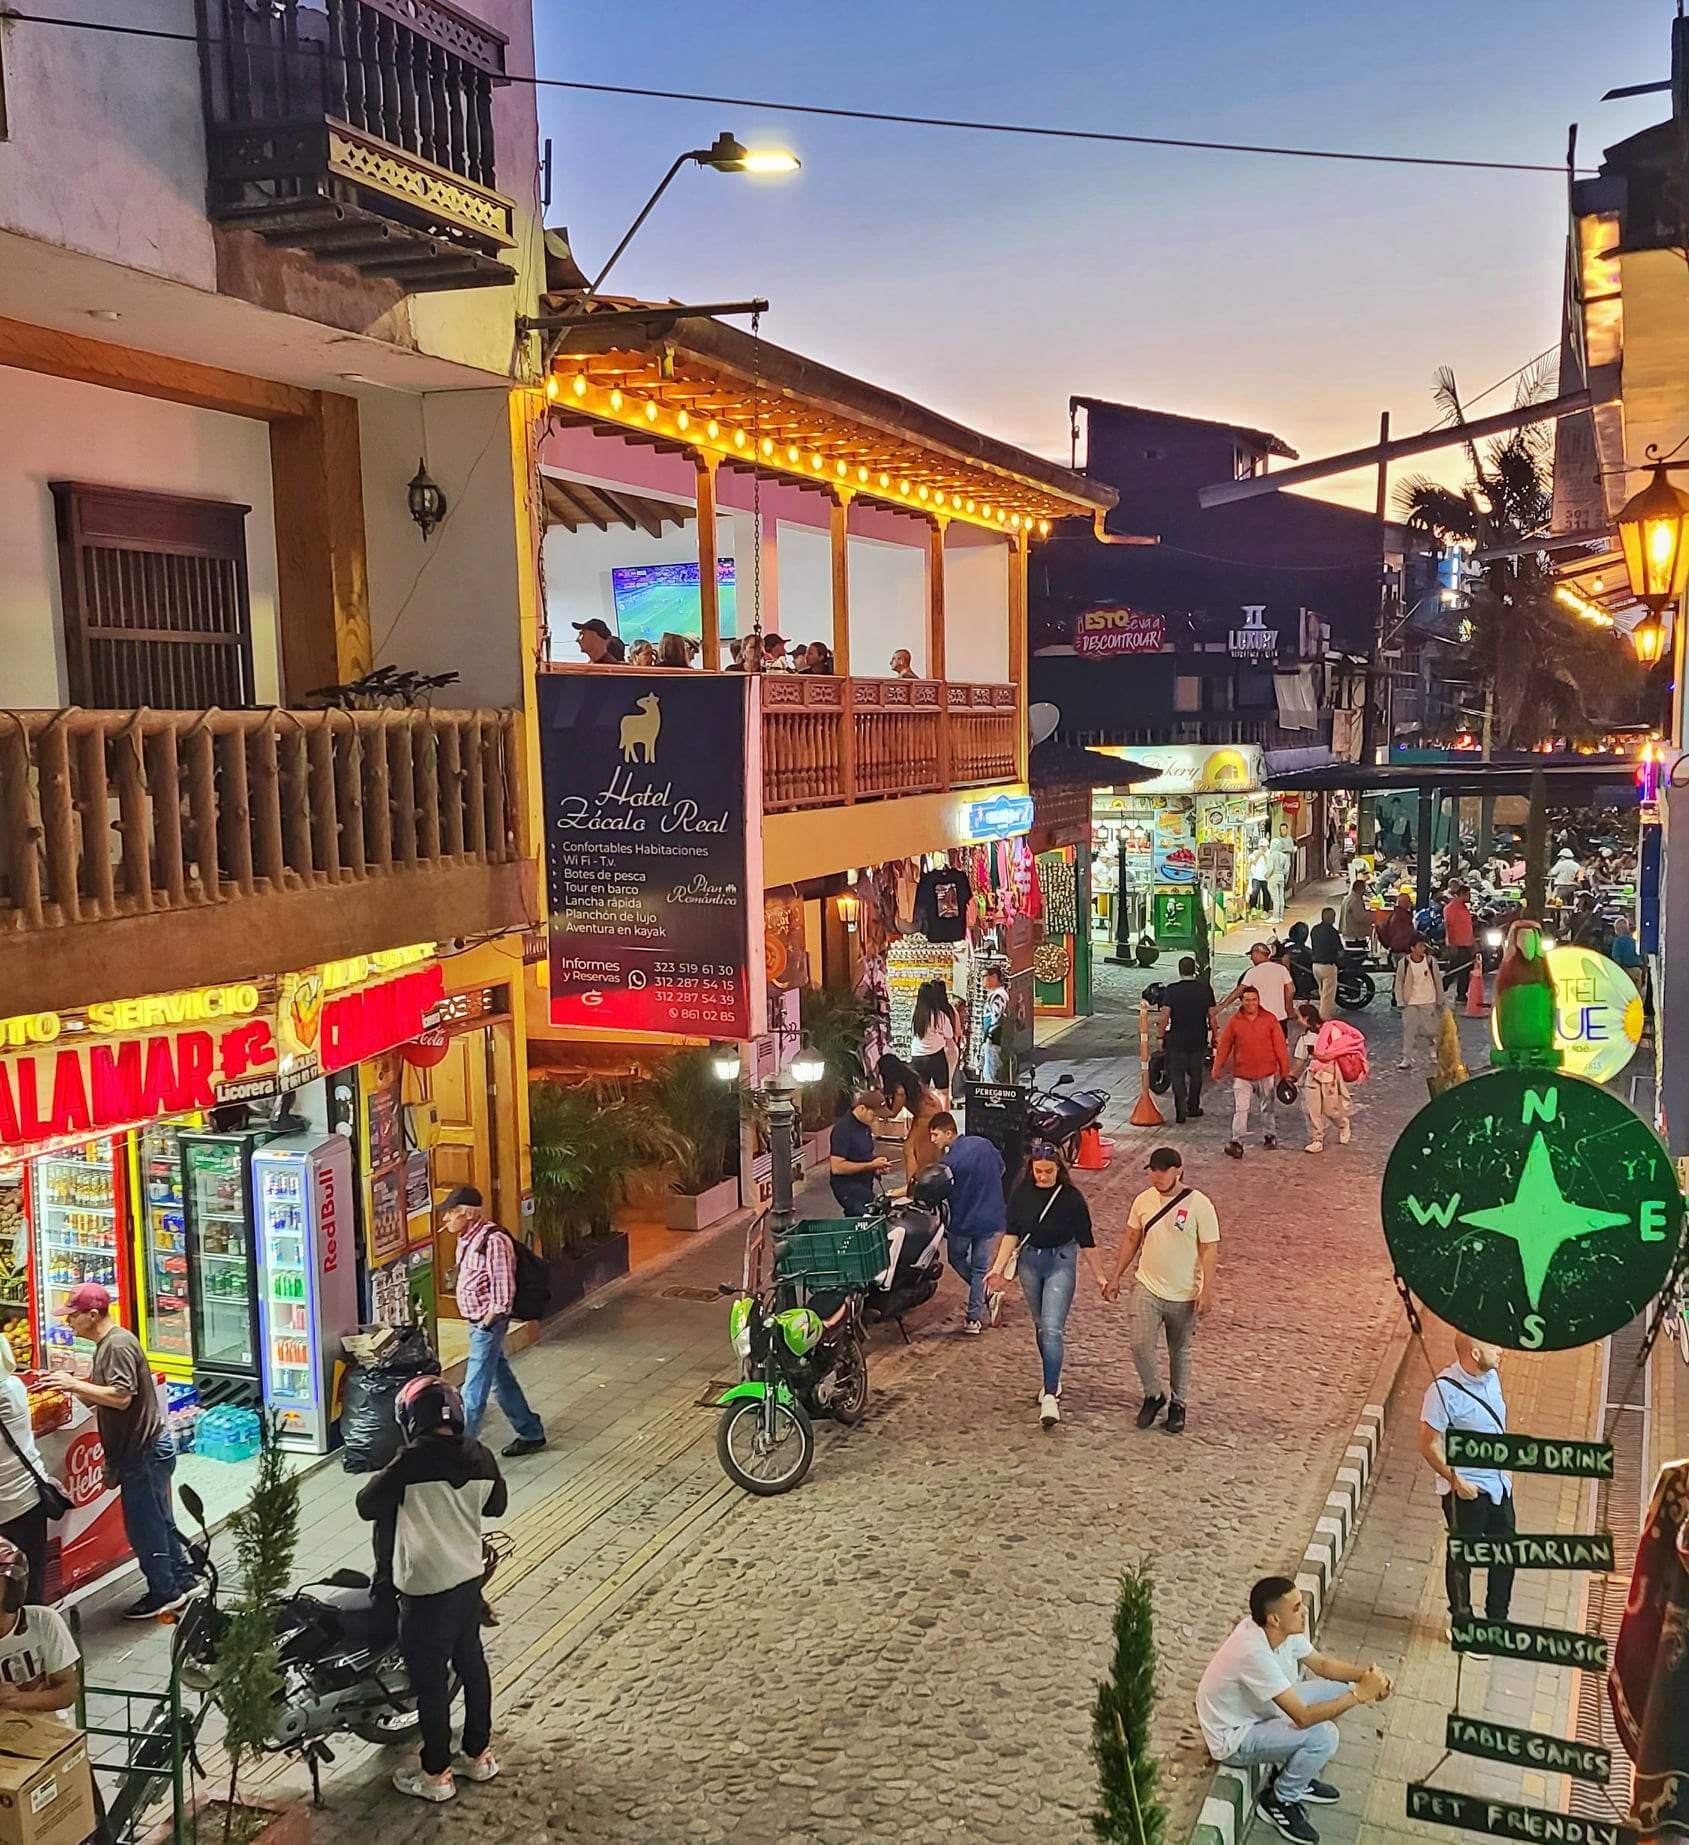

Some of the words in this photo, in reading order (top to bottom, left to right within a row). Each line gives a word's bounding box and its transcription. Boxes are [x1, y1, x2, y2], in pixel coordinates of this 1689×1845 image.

[1082, 630, 1161, 651] DESCONTROLAR!
[1229, 630, 1279, 650] LUXURY
[596, 765, 673, 808] Hotel
[557, 796, 646, 830] Zócalo
[661, 798, 728, 834] Real
[563, 842, 632, 855] Confortables
[635, 844, 709, 857] Habitaciones
[563, 856, 576, 866] Wi
[578, 857, 591, 867] Fi
[564, 868, 595, 880] Botes
[597, 869, 612, 881] de
[614, 872, 646, 883] pesca
[687, 874, 721, 894] Plan
[564, 882, 588, 893] Tour
[590, 885, 604, 894] en
[607, 884, 639, 895] barco
[565, 896, 604, 907] Lancha
[607, 897, 642, 910] rápida
[566, 910, 616, 922] Planchón
[619, 911, 633, 922] de
[636, 912, 657, 925] lujo
[566, 922, 614, 935] Aventura
[617, 926, 632, 936] en
[634, 925, 666, 938] kayak
[562, 958, 620, 972] Informes
[654, 962, 675, 973] 323
[678, 963, 698, 974] 519
[702, 964, 715, 975] 61
[718, 965, 733, 976] 30
[563, 973, 570, 982] y
[573, 971, 621, 983] Reservas
[654, 977, 673, 987] 312
[677, 978, 699, 988] 287
[703, 979, 718, 990] 54
[722, 980, 735, 991] 15
[88, 984, 259, 1033] SERVICIO
[655, 992, 673, 1002] 312
[677, 993, 698, 1003] 287
[701, 994, 717, 1004] 54
[720, 995, 734, 1005] 39
[681, 1009, 700, 1020] 861
[703, 1010, 718, 1021] 02
[720, 1011, 735, 1022] 85
[419, 1028, 446, 1047] Cola
[216, 1079, 274, 1103] Licorera
[975, 1088, 1017, 1098] PEREGRINO
[1522, 1087, 1558, 1125] N
[1407, 1192, 1461, 1229] W
[1640, 1201, 1667, 1242] E
[1519, 1314, 1546, 1349] S
[72, 1443, 104, 1475] Cre
[1449, 1436, 1508, 1463] FOOD
[1544, 1446, 1613, 1473] DRINK
[1450, 1539, 1610, 1565] FLEXITARIAN
[1452, 1623, 1531, 1650] WORLD
[1536, 1637, 1608, 1665] MUSIC
[1453, 1721, 1521, 1754] TABLE
[1527, 1738, 1611, 1777] GAMES
[1413, 1792, 1466, 1818] PET
[1487, 1807, 1618, 1845] FRIENDLY
